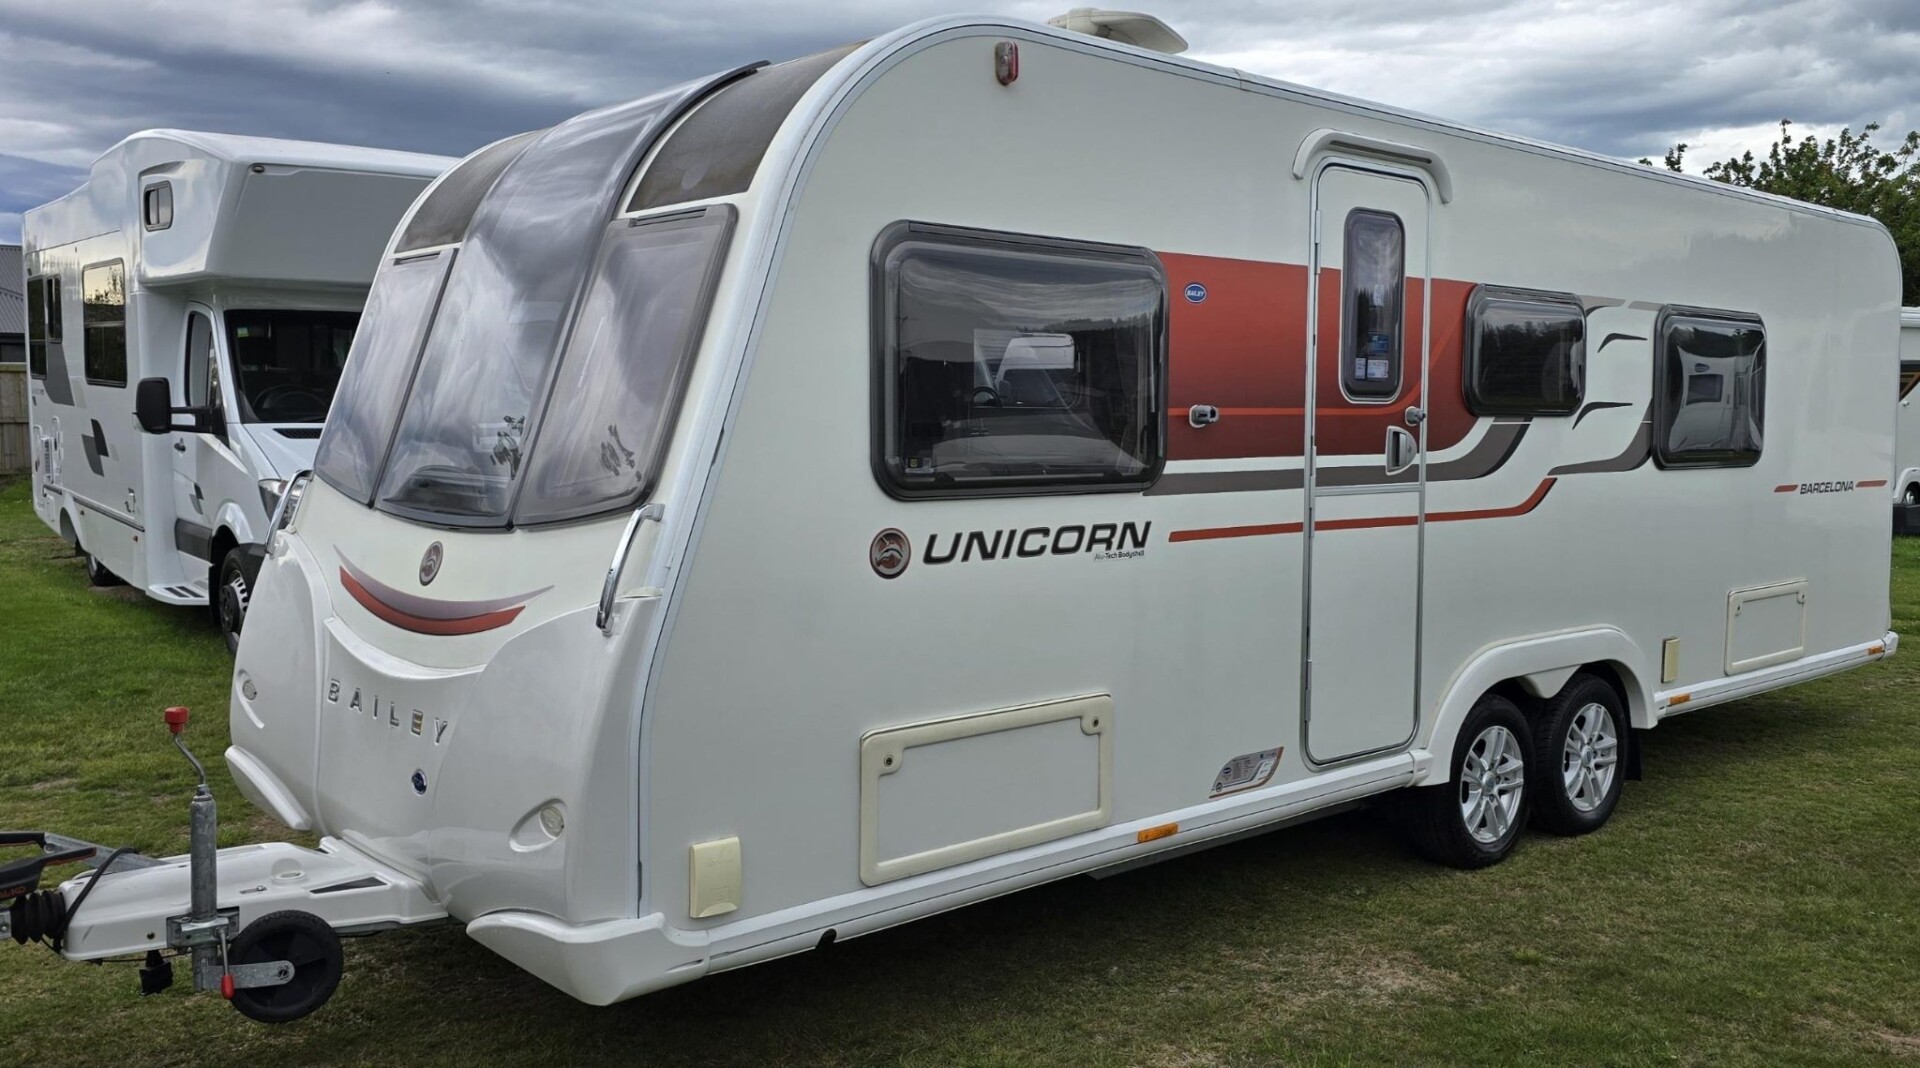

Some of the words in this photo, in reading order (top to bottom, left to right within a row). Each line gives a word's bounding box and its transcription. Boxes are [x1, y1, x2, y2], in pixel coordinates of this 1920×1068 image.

[1799, 481, 1854, 495] BARCELONA
[923, 521, 1152, 565] UNICORN
[327, 678, 448, 745] BAILEY
